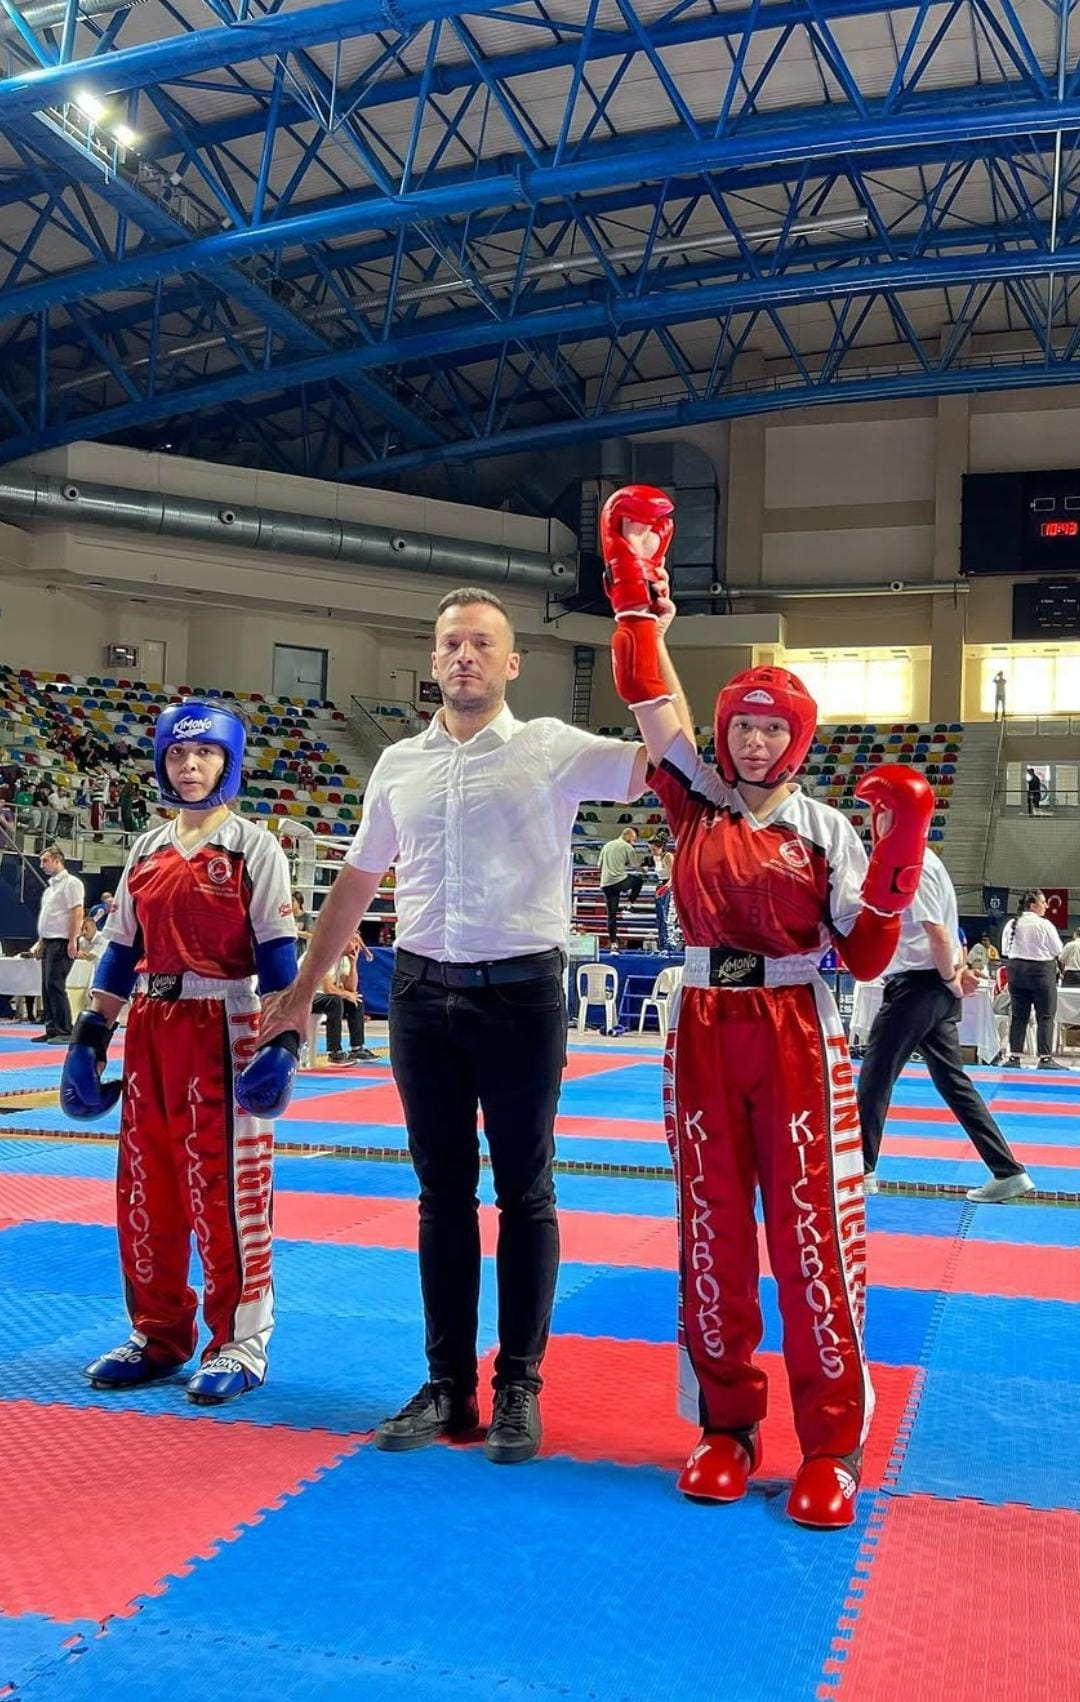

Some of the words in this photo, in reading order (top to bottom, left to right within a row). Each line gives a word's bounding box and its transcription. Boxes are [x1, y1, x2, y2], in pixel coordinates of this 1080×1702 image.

[172, 715, 211, 738] KIMONO
[718, 955, 757, 983] KIMONO
[126, 1071, 153, 1284] KICKBOKS
[684, 1110, 725, 1358] KICKBOKS
[788, 1110, 844, 1379] KICKBOKS
